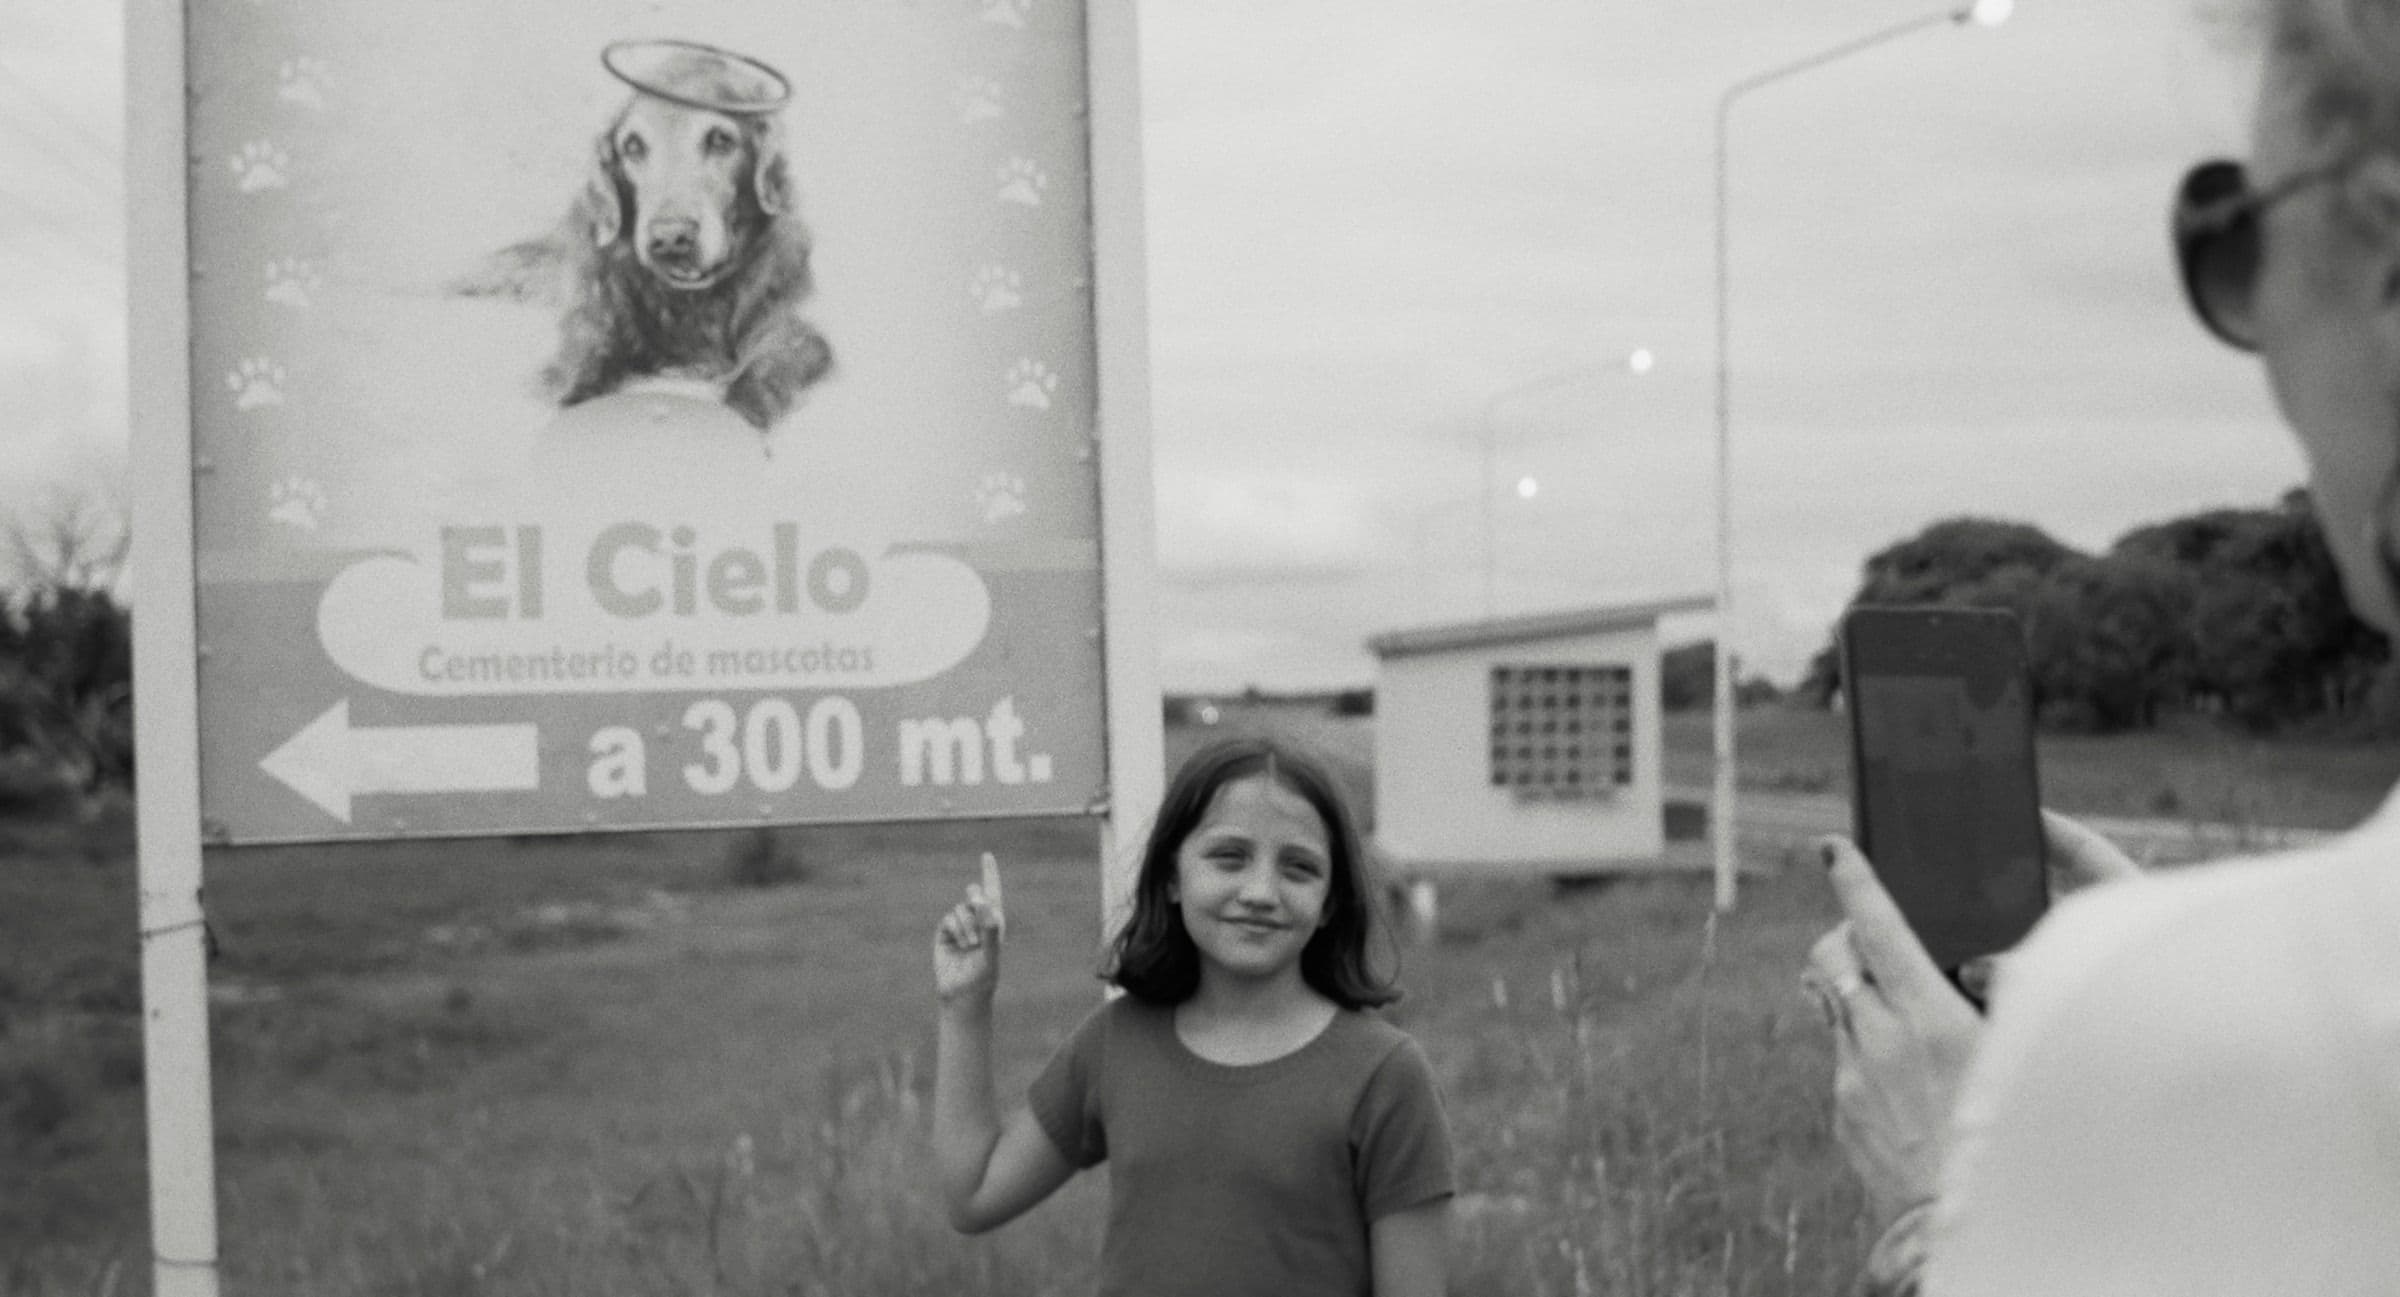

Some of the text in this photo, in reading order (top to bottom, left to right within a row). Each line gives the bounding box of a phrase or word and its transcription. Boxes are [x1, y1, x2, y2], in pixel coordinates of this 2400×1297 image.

[439, 521, 871, 620] El Cielo
[418, 639, 874, 683] Cementerio de mascotas
[588, 694, 1053, 797] a 300 mt.
